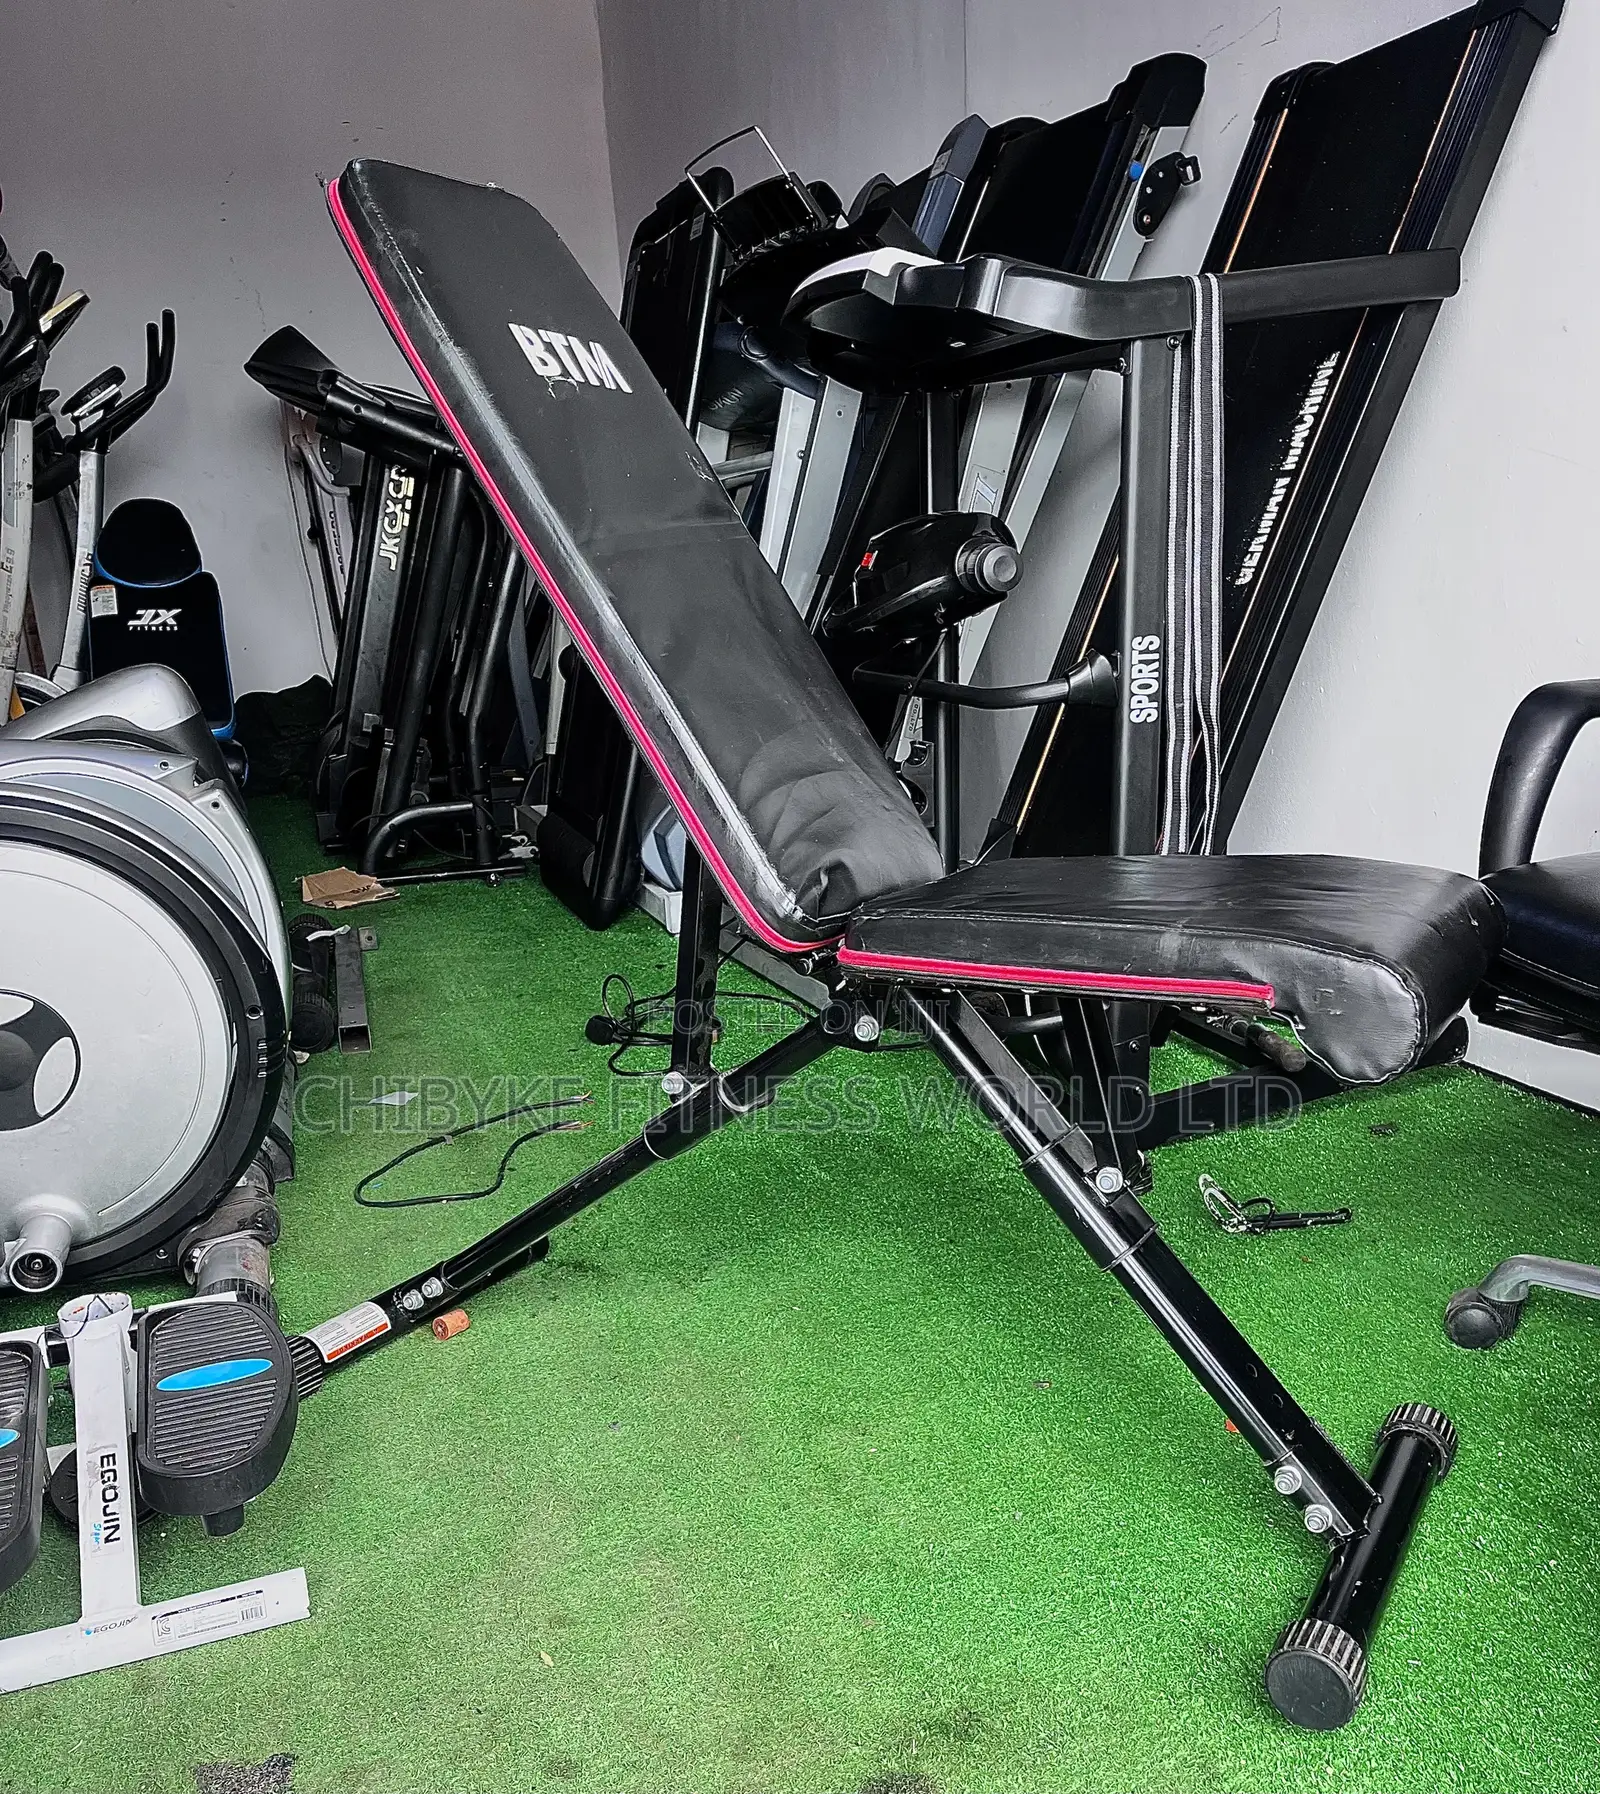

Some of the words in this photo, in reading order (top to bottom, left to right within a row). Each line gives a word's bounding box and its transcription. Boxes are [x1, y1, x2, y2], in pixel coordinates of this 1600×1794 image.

[507, 322, 633, 394] BTM
[127, 608, 182, 626] JX
[1129, 634, 1161, 724] SPORTS
[100, 1453, 121, 1545] EGOJIN
